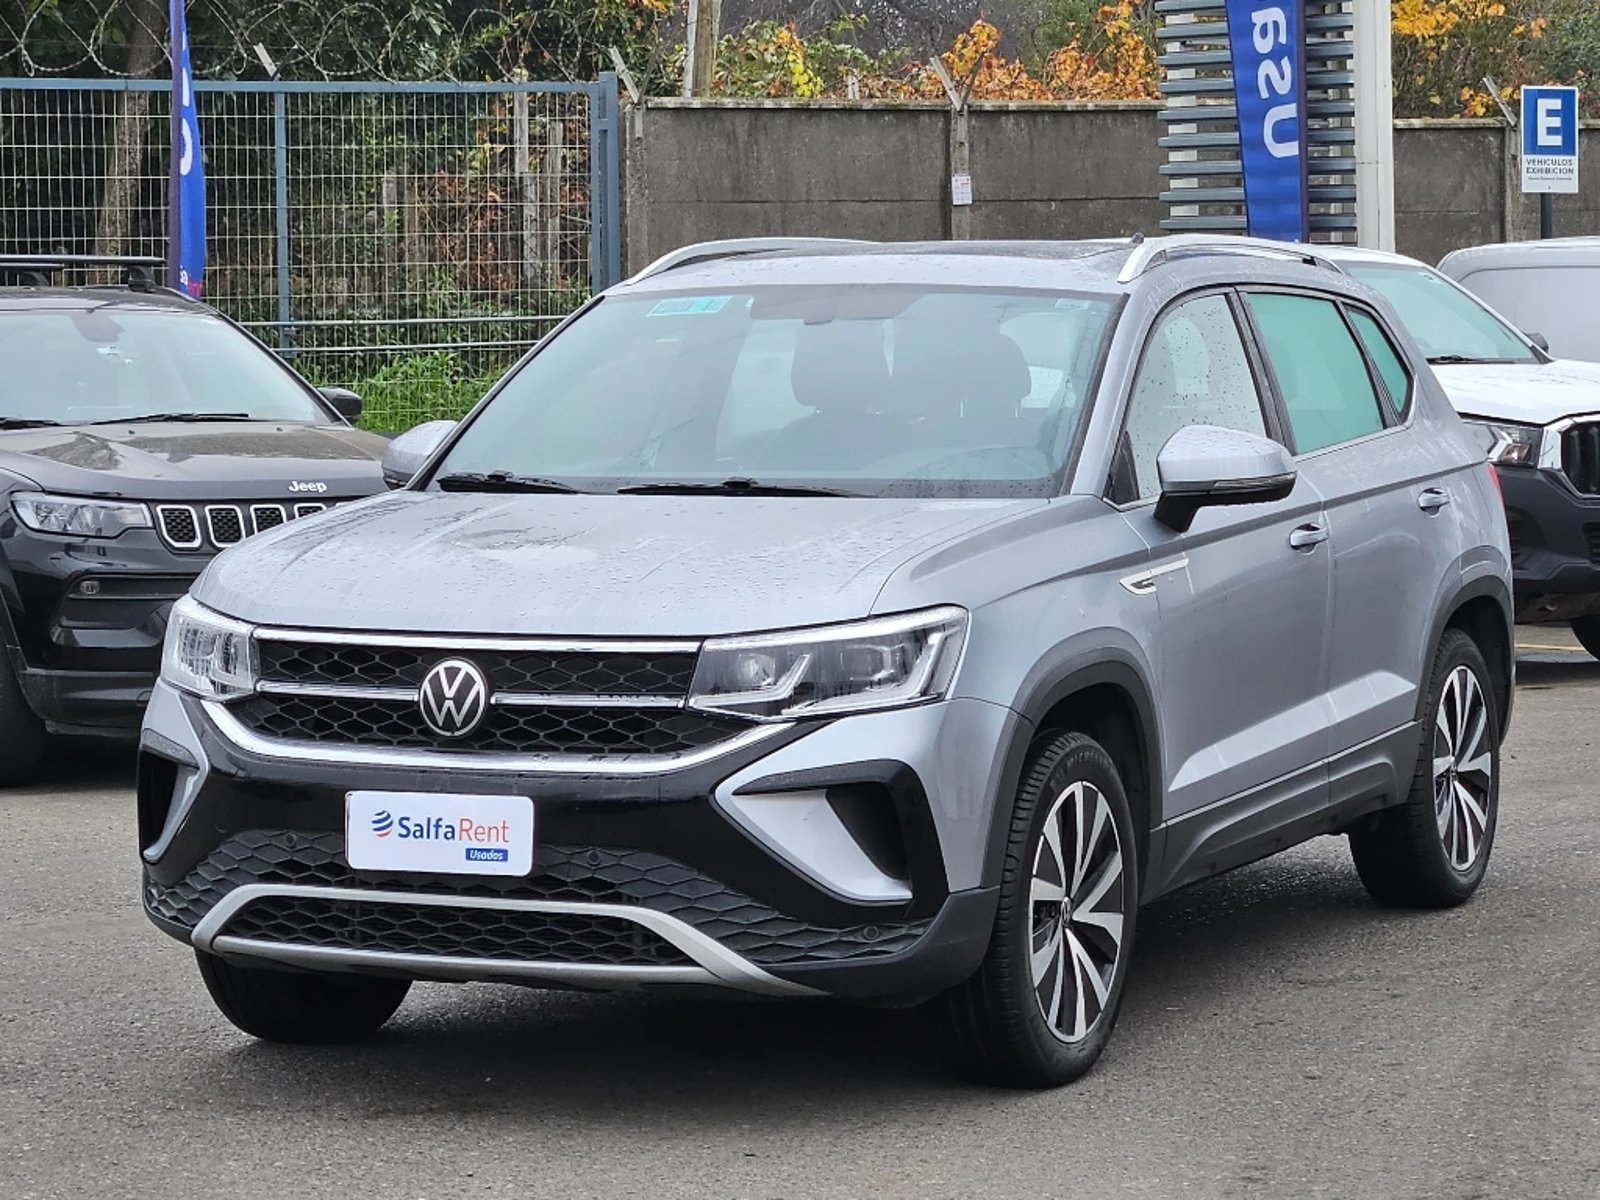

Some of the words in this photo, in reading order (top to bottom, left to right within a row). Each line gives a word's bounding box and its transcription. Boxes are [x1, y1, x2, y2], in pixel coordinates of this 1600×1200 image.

[1536, 98, 1562, 146] E
[1525, 158, 1573, 166] VEHICULOS
[1525, 166, 1574, 174] EXHIBICION
[288, 480, 328, 493] Jeep
[422, 662, 483, 732] VW
[469, 849, 504, 860] Usados
